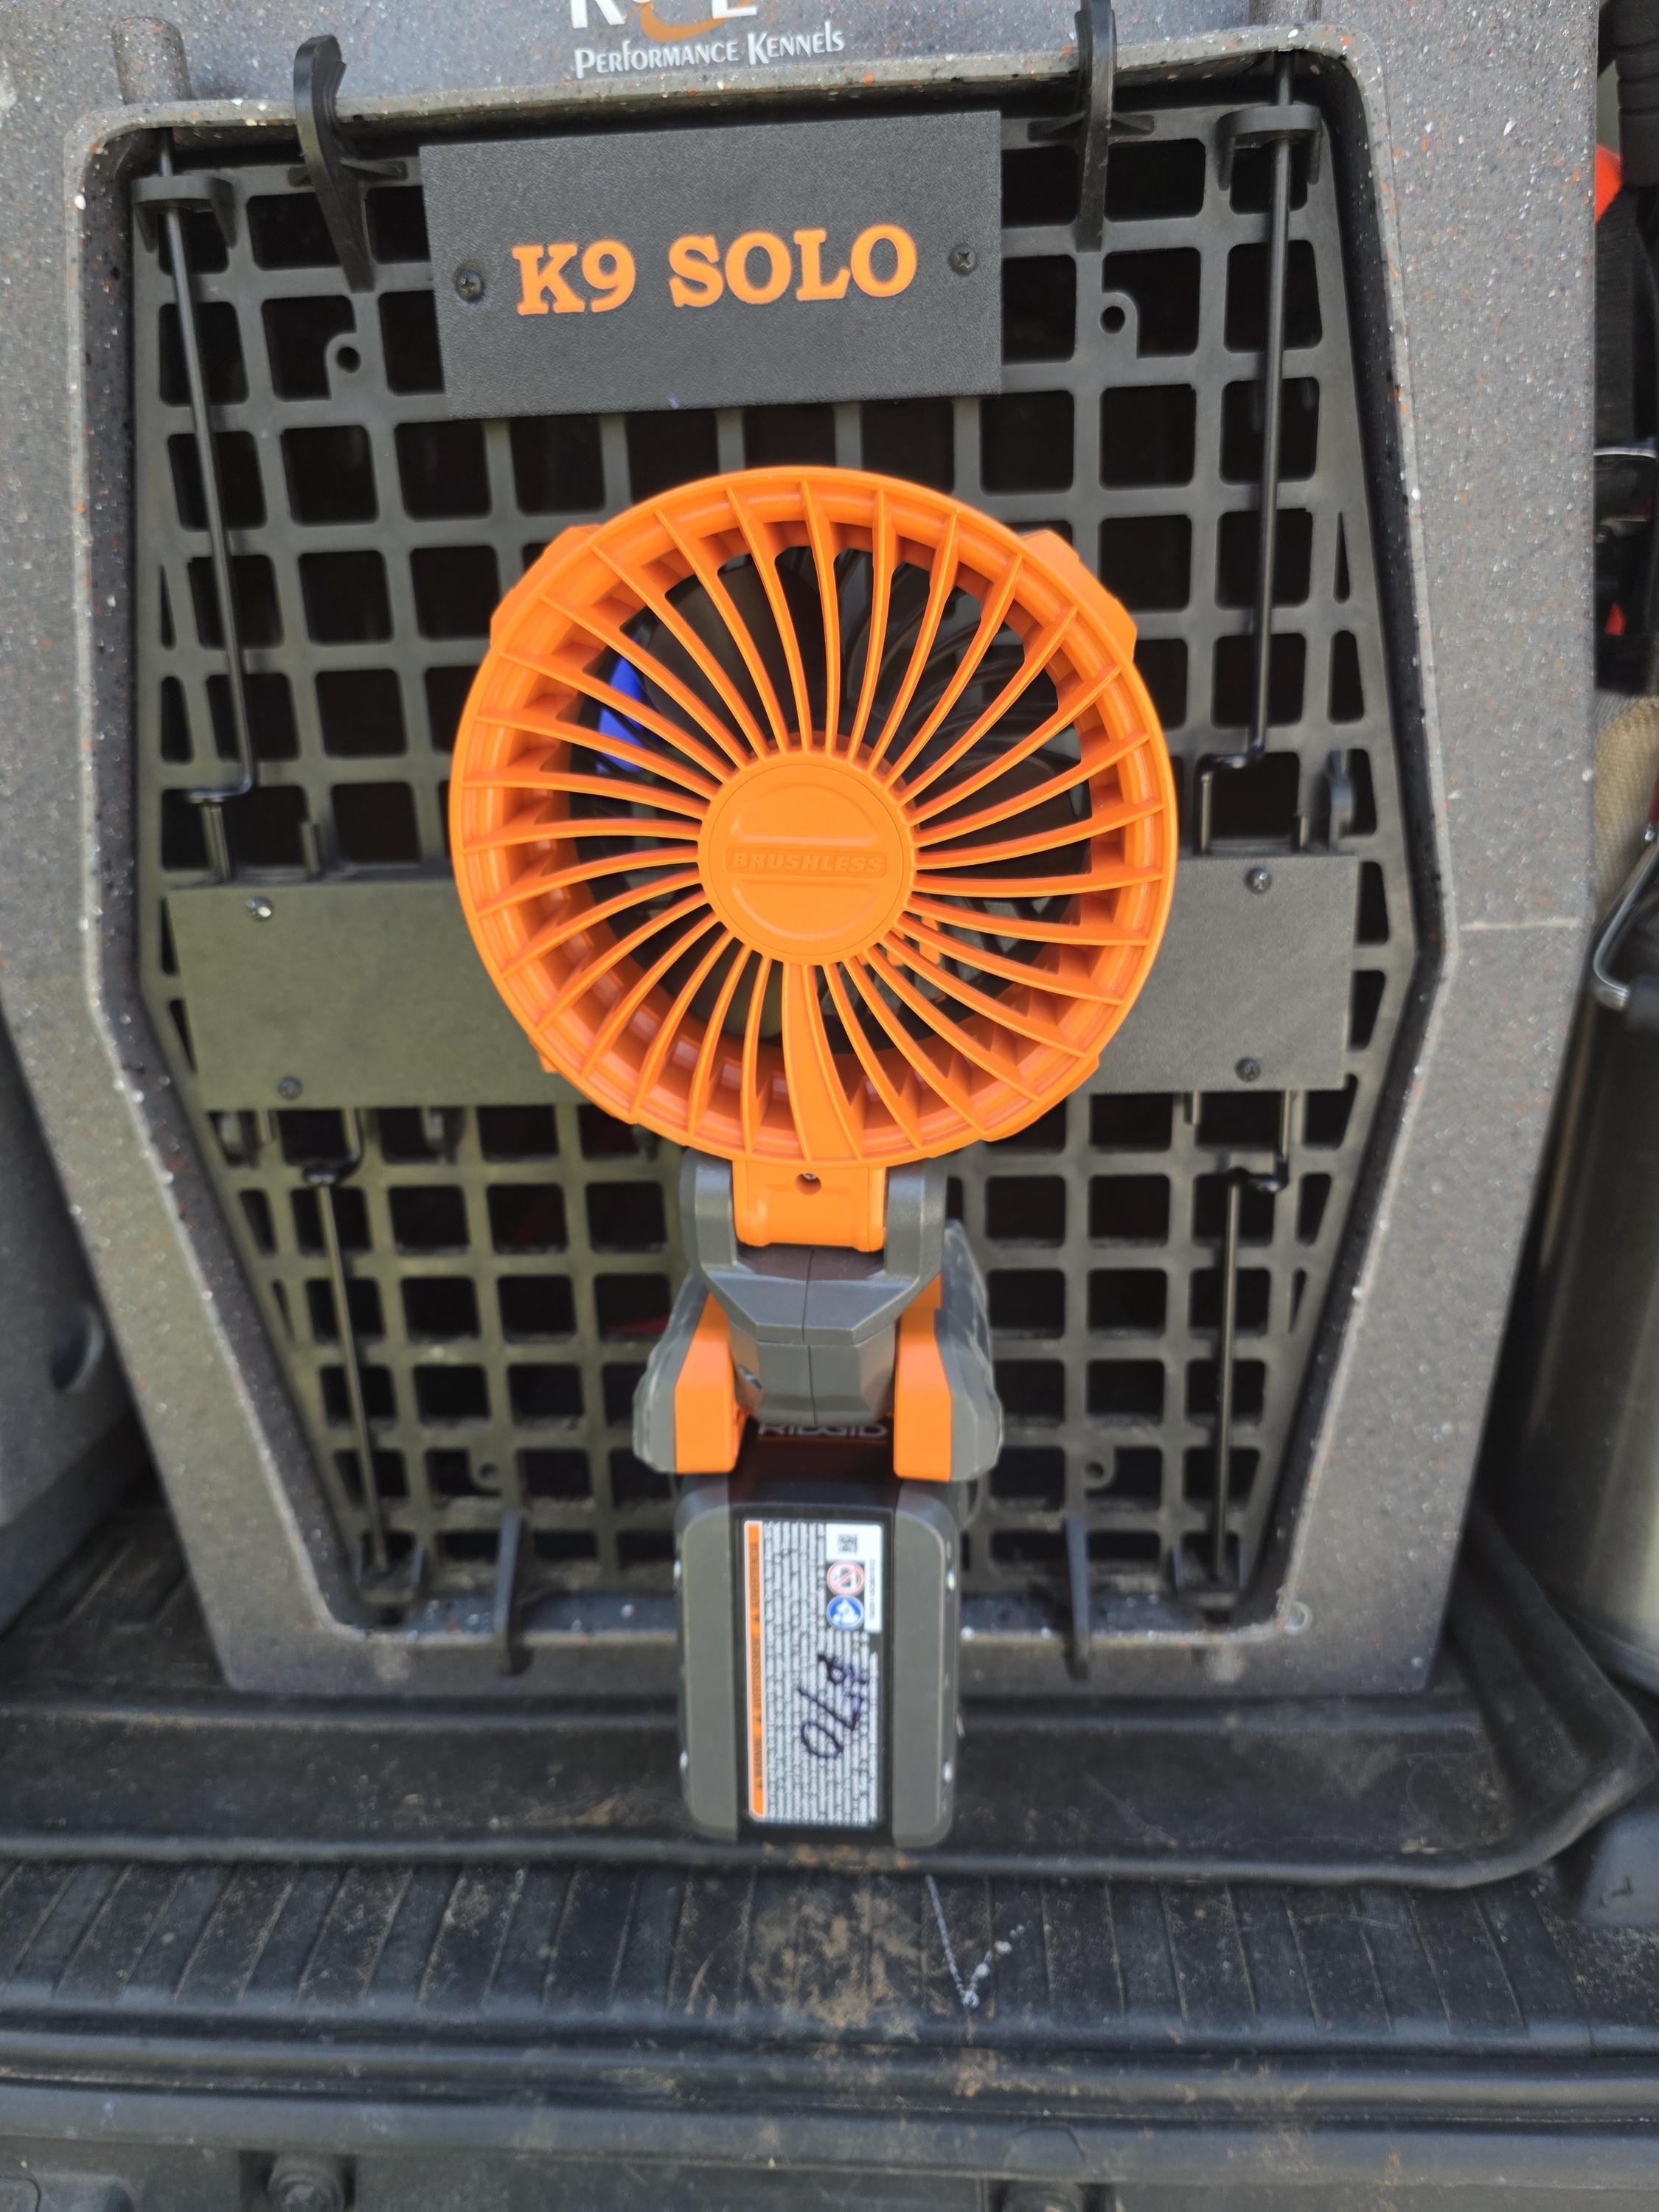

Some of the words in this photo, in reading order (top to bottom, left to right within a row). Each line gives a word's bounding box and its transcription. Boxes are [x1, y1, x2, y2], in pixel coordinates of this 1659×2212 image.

[512, 238, 636, 316] K9
[668, 223, 918, 308] SOLO
[731, 852, 884, 874] BRUSHLESS
